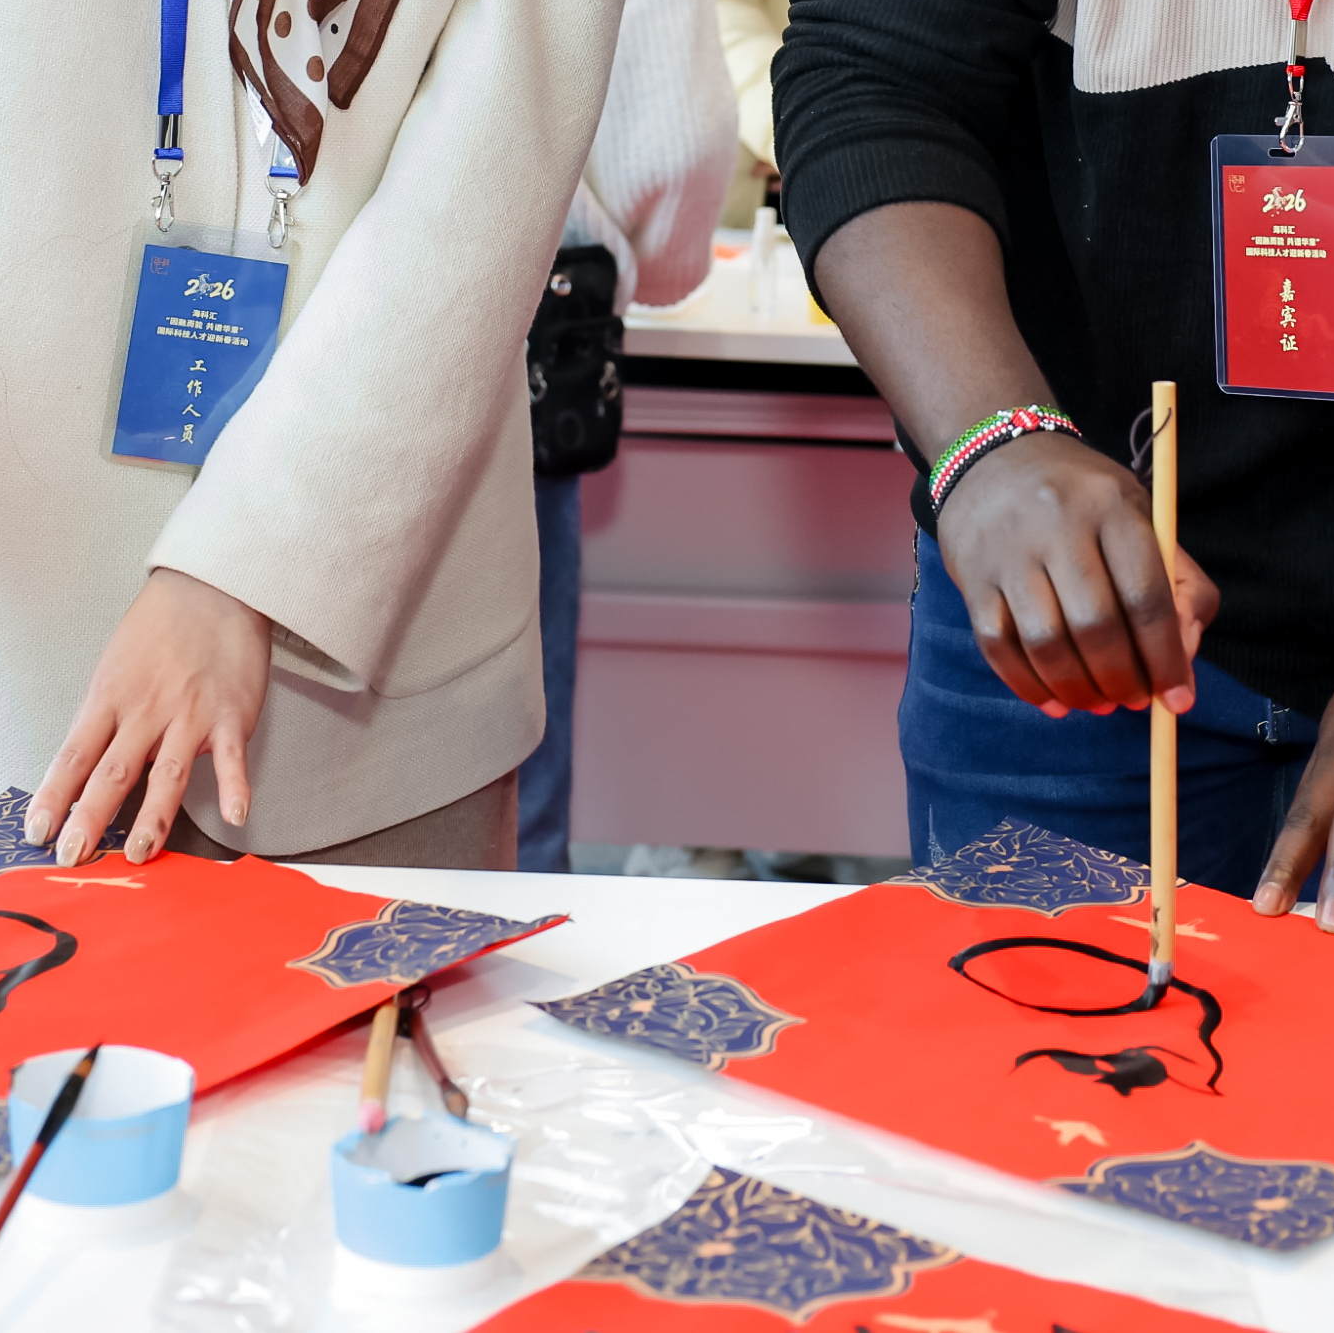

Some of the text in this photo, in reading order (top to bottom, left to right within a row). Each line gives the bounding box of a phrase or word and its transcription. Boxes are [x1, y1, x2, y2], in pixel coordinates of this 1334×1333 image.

[156, 326, 249, 347] 国际科技人才迎新春活动
[1278, 278, 1299, 352] 嘉宾证
[180, 359, 207, 445] 工作人员
